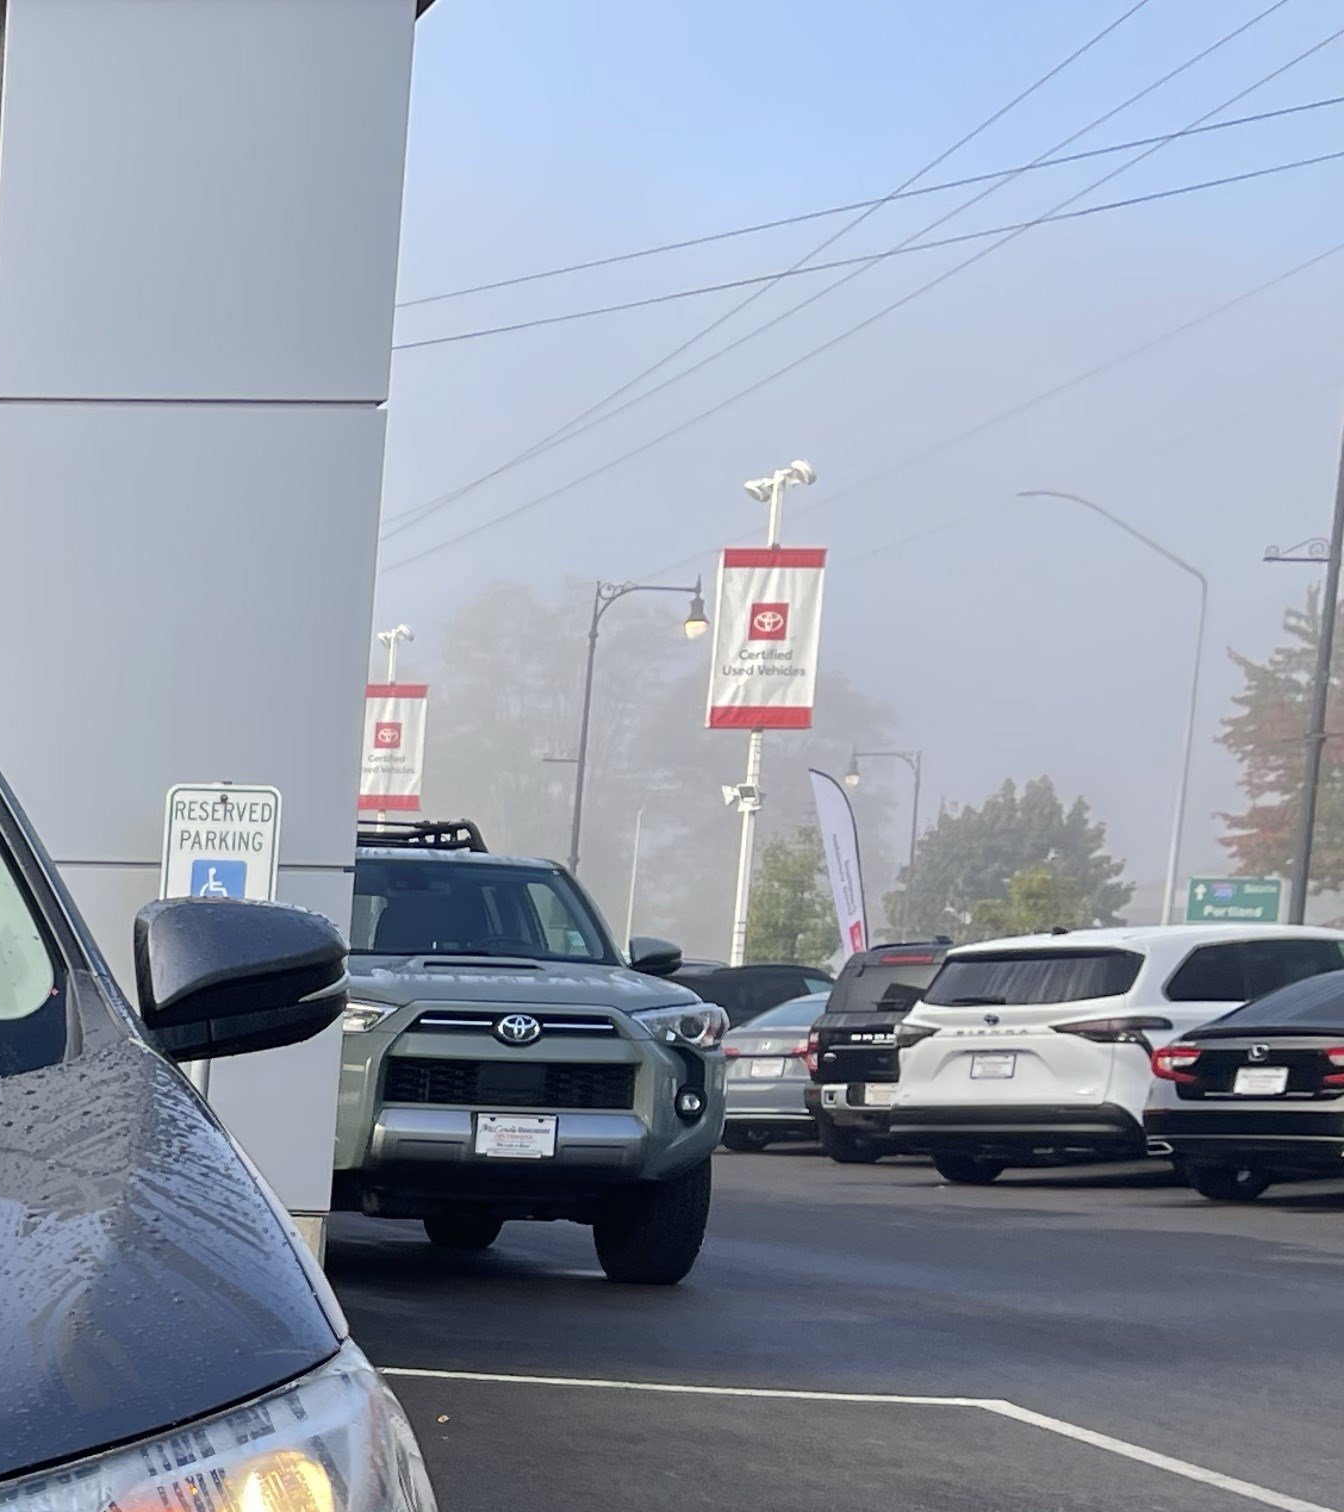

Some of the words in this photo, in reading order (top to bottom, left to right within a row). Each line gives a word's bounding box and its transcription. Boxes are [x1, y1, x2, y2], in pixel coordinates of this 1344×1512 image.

[738, 648, 793, 660] Certified
[722, 664, 754, 676] Used
[757, 664, 806, 676] Vehicles
[174, 800, 273, 823] RESERVED
[179, 829, 264, 852] PARKING
